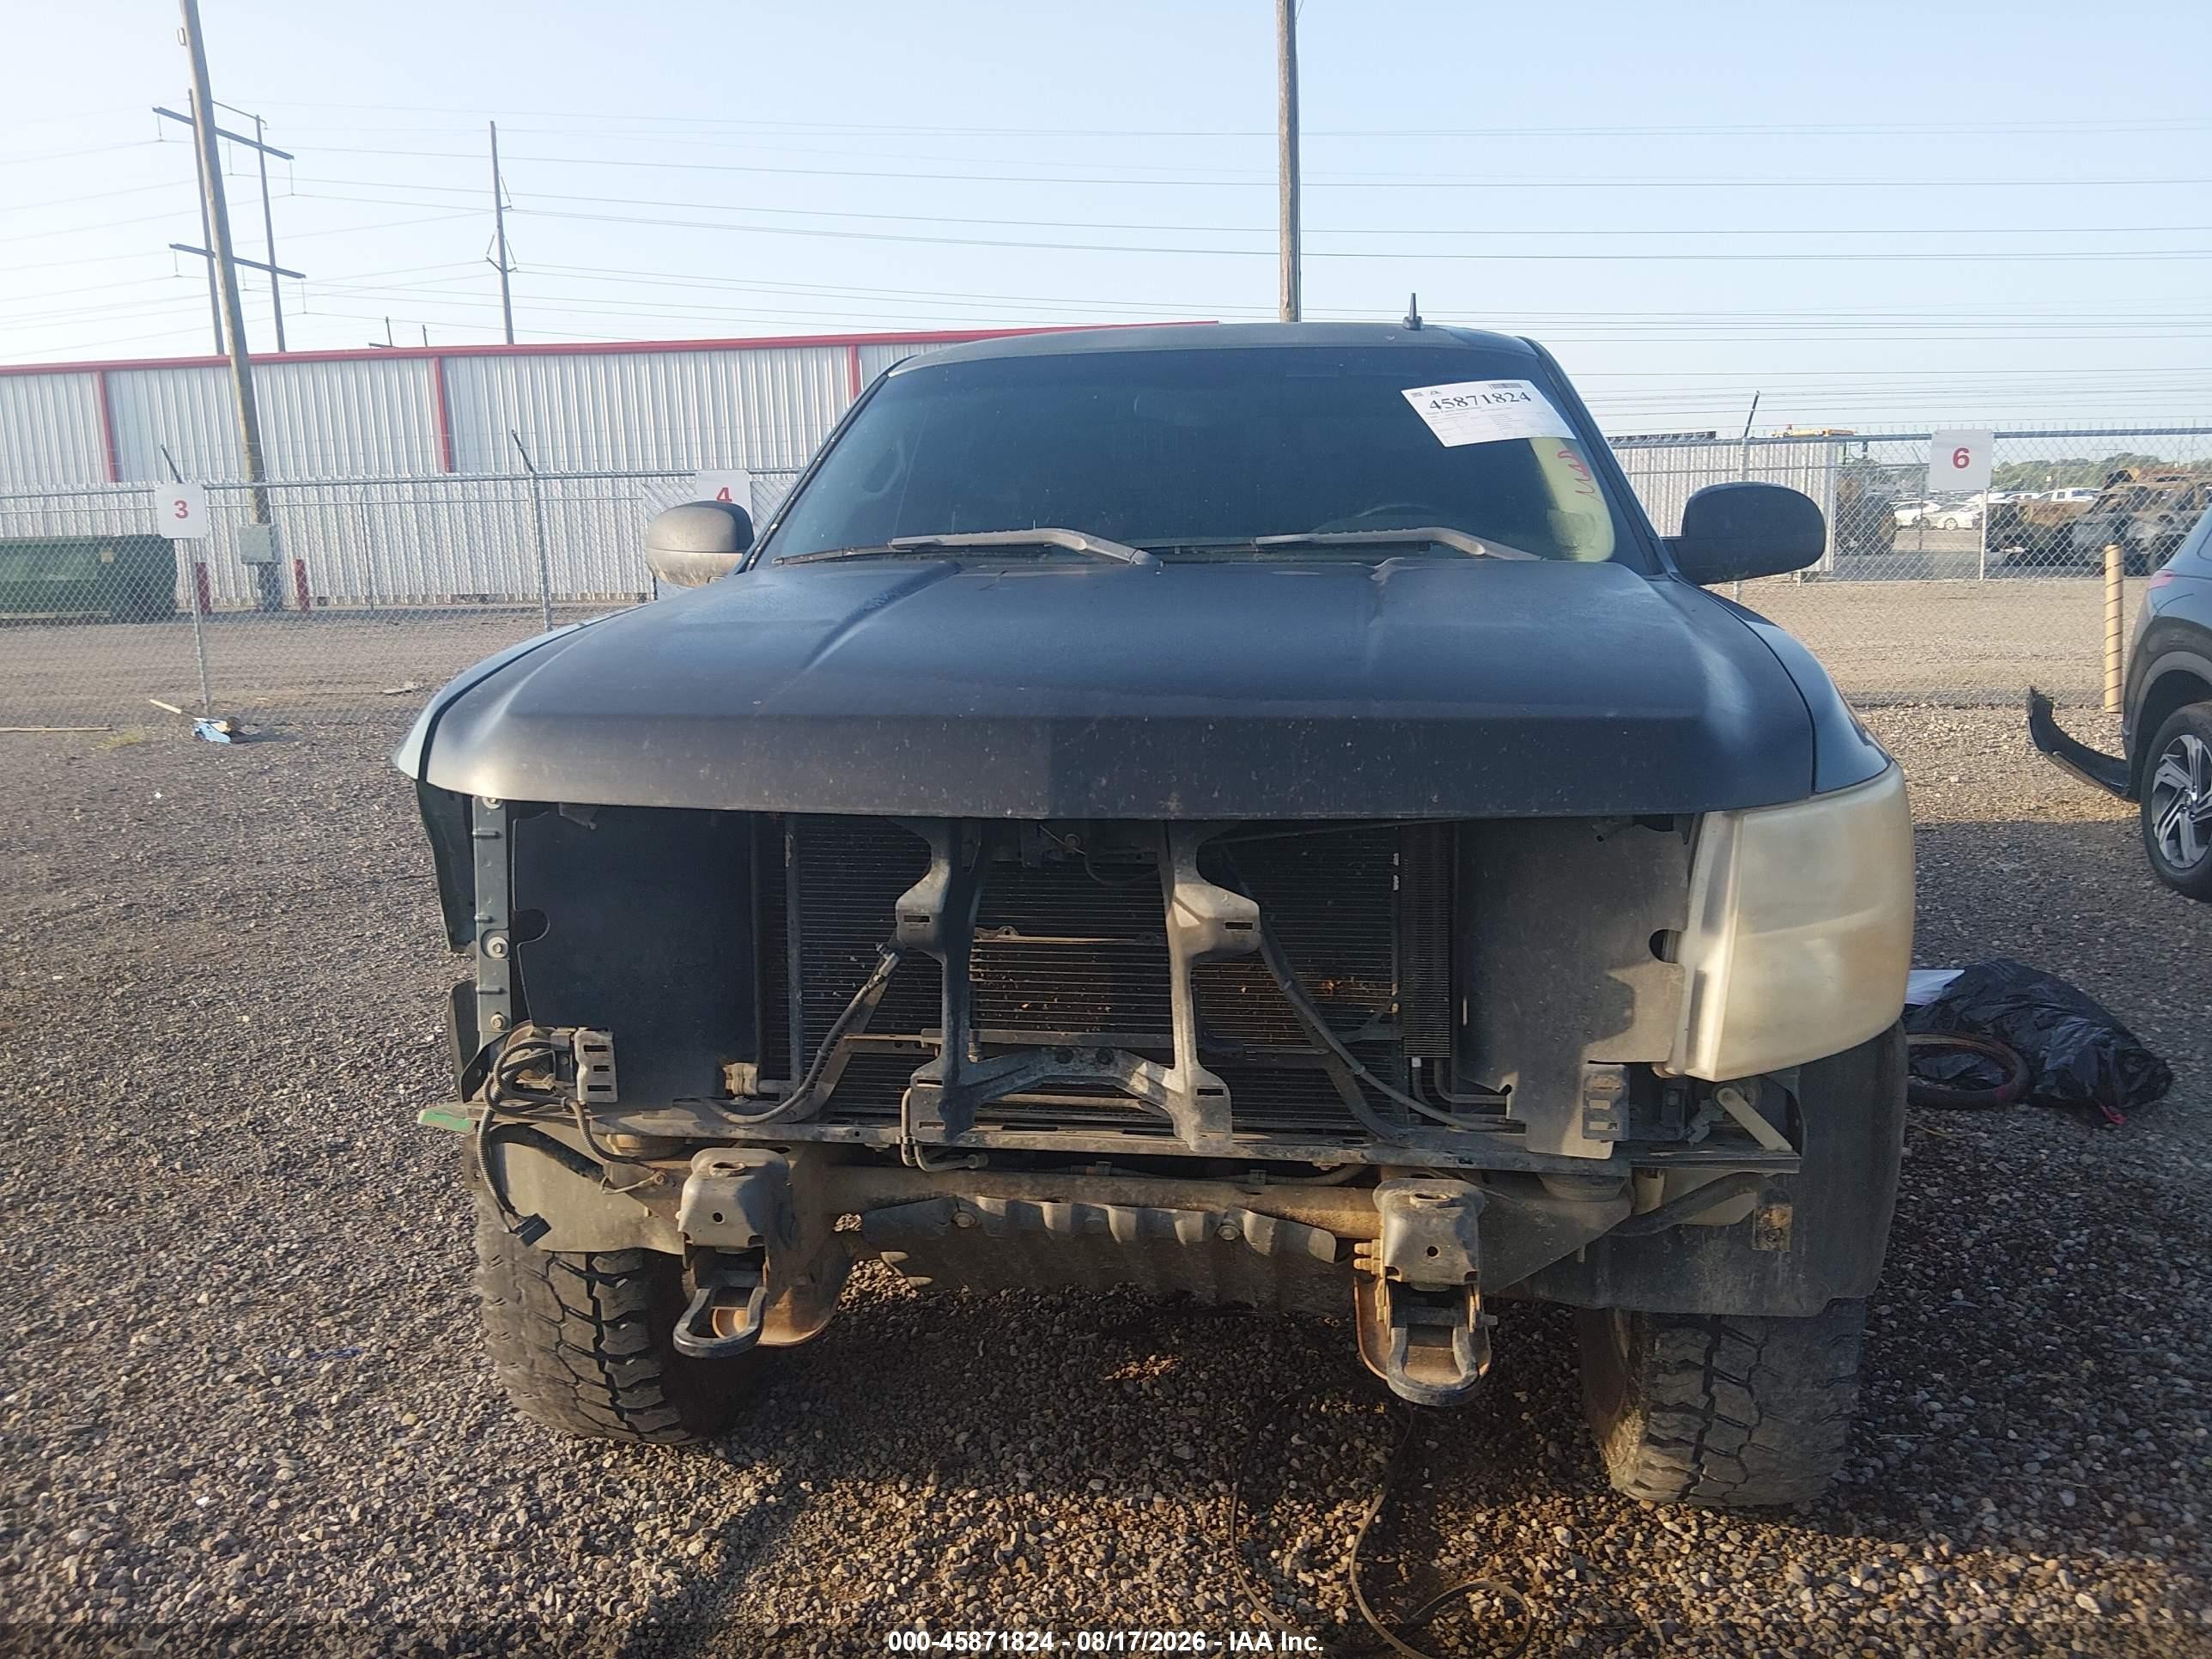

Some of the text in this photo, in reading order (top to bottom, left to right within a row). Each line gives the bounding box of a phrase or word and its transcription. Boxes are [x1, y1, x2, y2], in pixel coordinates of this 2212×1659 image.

[1429, 391, 1531, 411] 45871824
[1952, 448, 1971, 469] 6
[716, 486, 732, 502] 4
[173, 499, 189, 520] 3
